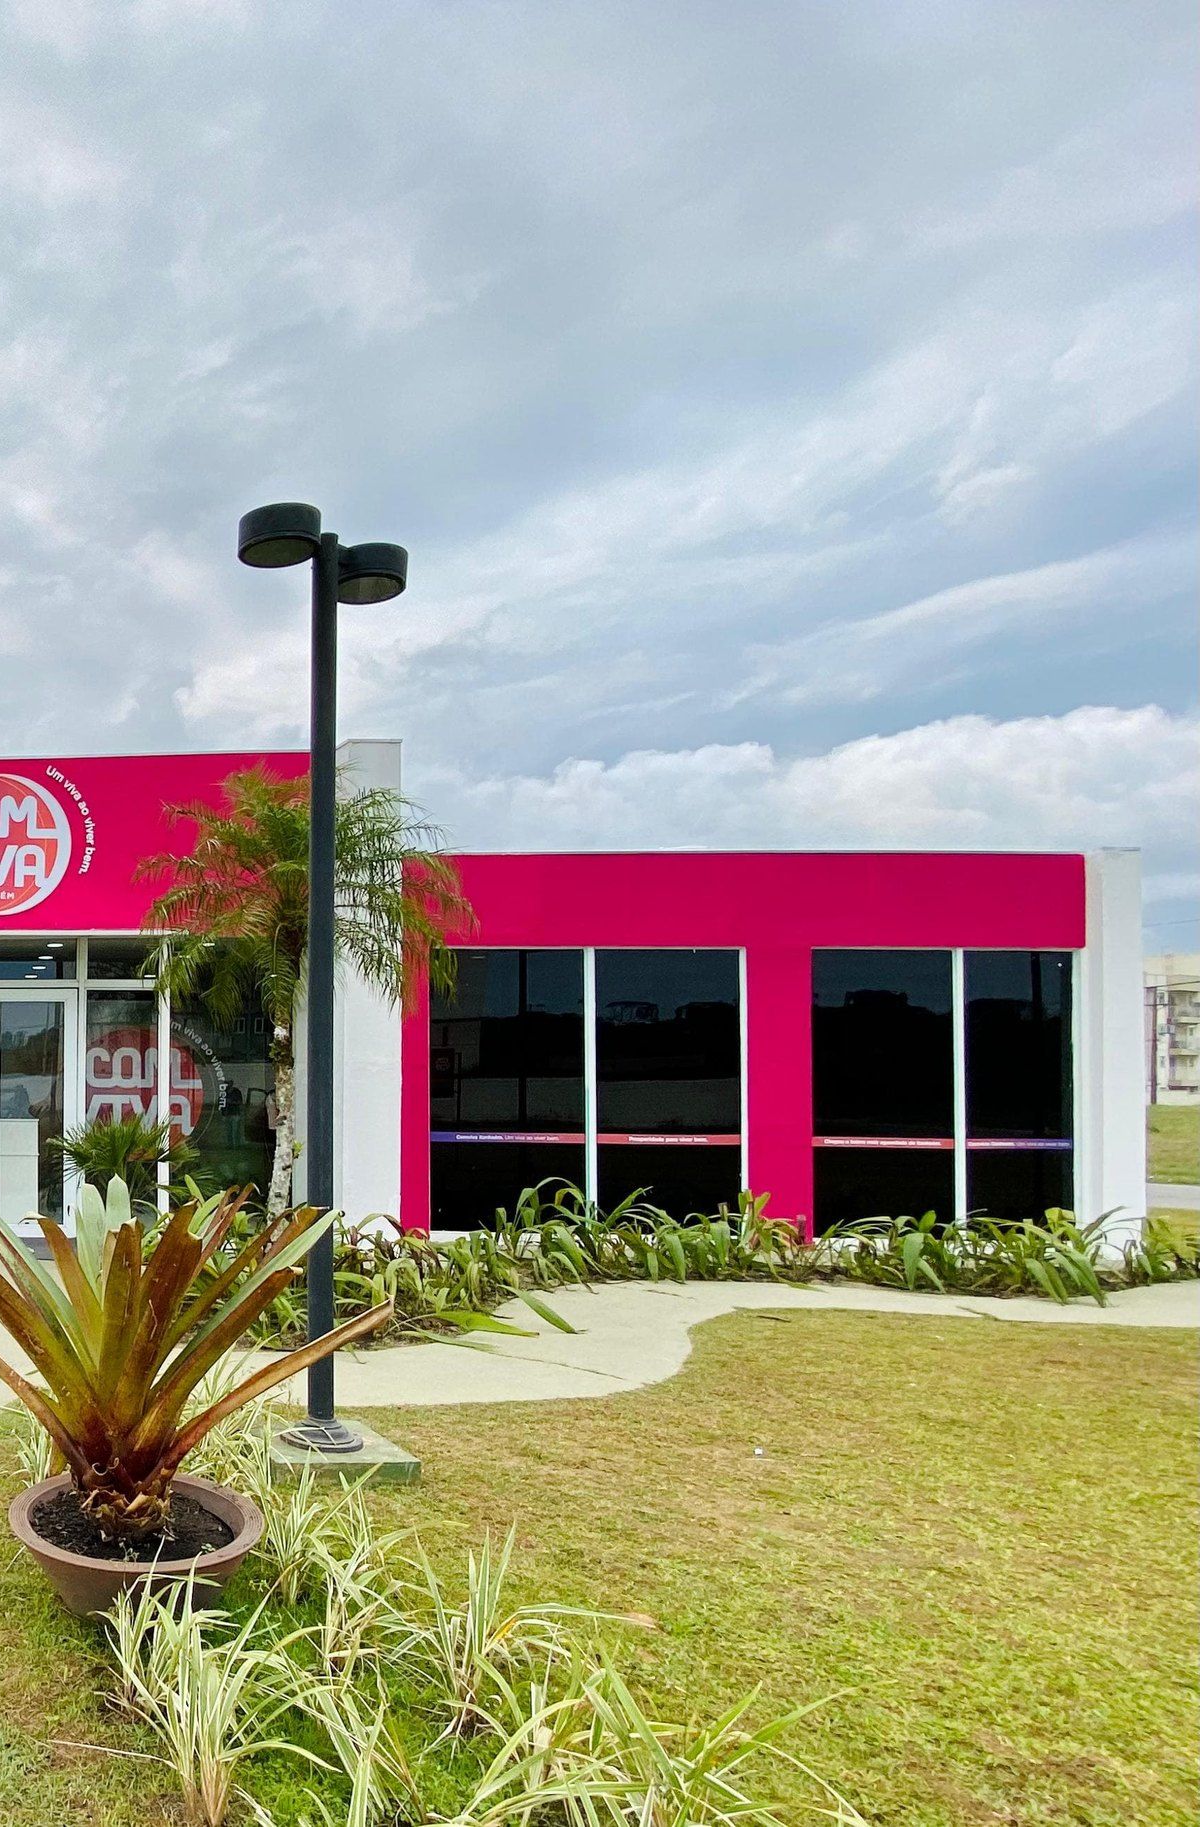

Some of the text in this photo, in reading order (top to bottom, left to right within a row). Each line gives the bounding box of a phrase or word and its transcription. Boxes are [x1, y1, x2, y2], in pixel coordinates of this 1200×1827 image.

[46, 765, 96, 875] Um viva ao viver bem.
[183, 1026, 202, 1045] viva
[200, 1043, 213, 1056] ao
[211, 1056, 225, 1081] viver
